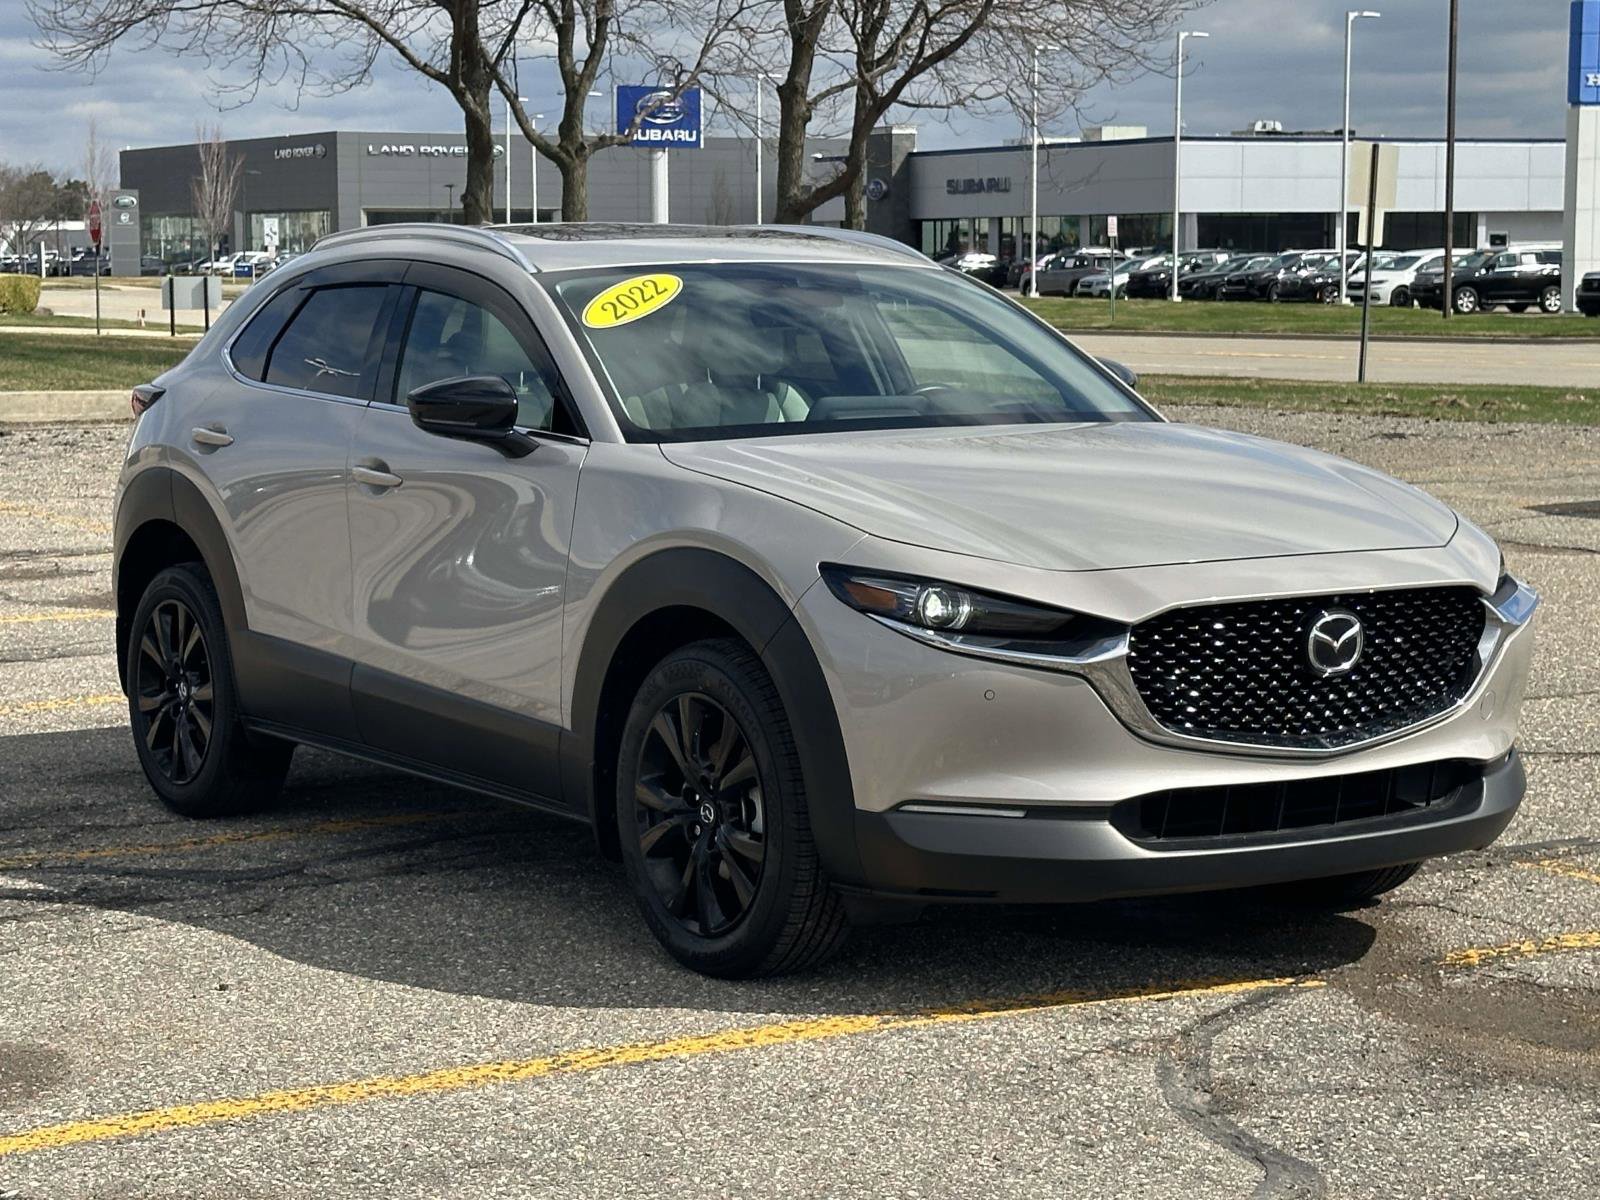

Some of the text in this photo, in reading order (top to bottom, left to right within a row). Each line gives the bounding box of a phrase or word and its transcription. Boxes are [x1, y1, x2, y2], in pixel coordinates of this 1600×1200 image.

[368, 144, 415, 155] LAND
[946, 176, 1011, 195] SUBARU
[600, 279, 669, 321] 2022
